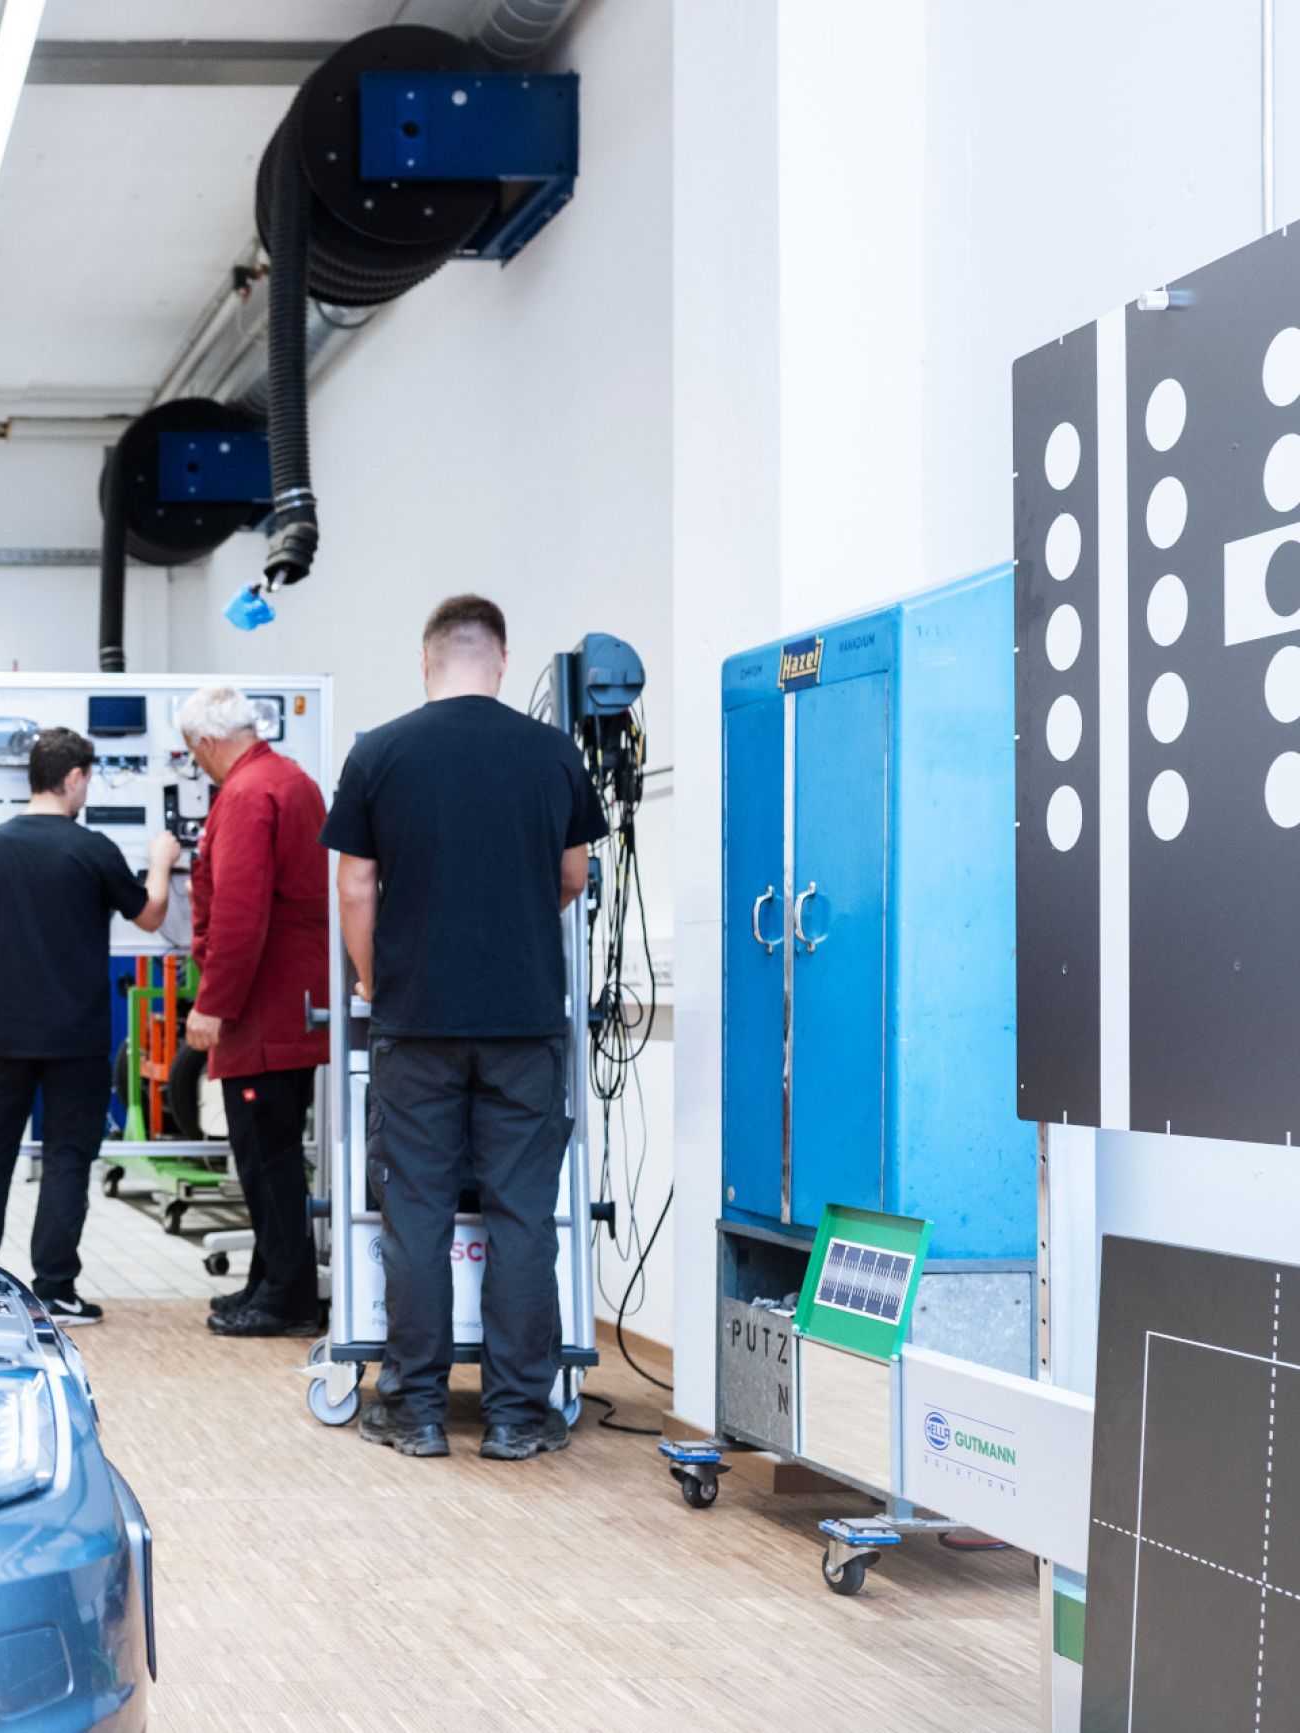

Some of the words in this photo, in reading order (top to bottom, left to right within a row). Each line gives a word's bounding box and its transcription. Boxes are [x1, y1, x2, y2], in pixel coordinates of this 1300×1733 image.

[731, 1319, 788, 1365] PUTZ
[778, 1384, 789, 1416] N
[955, 1431, 1016, 1465] GUTMANN
